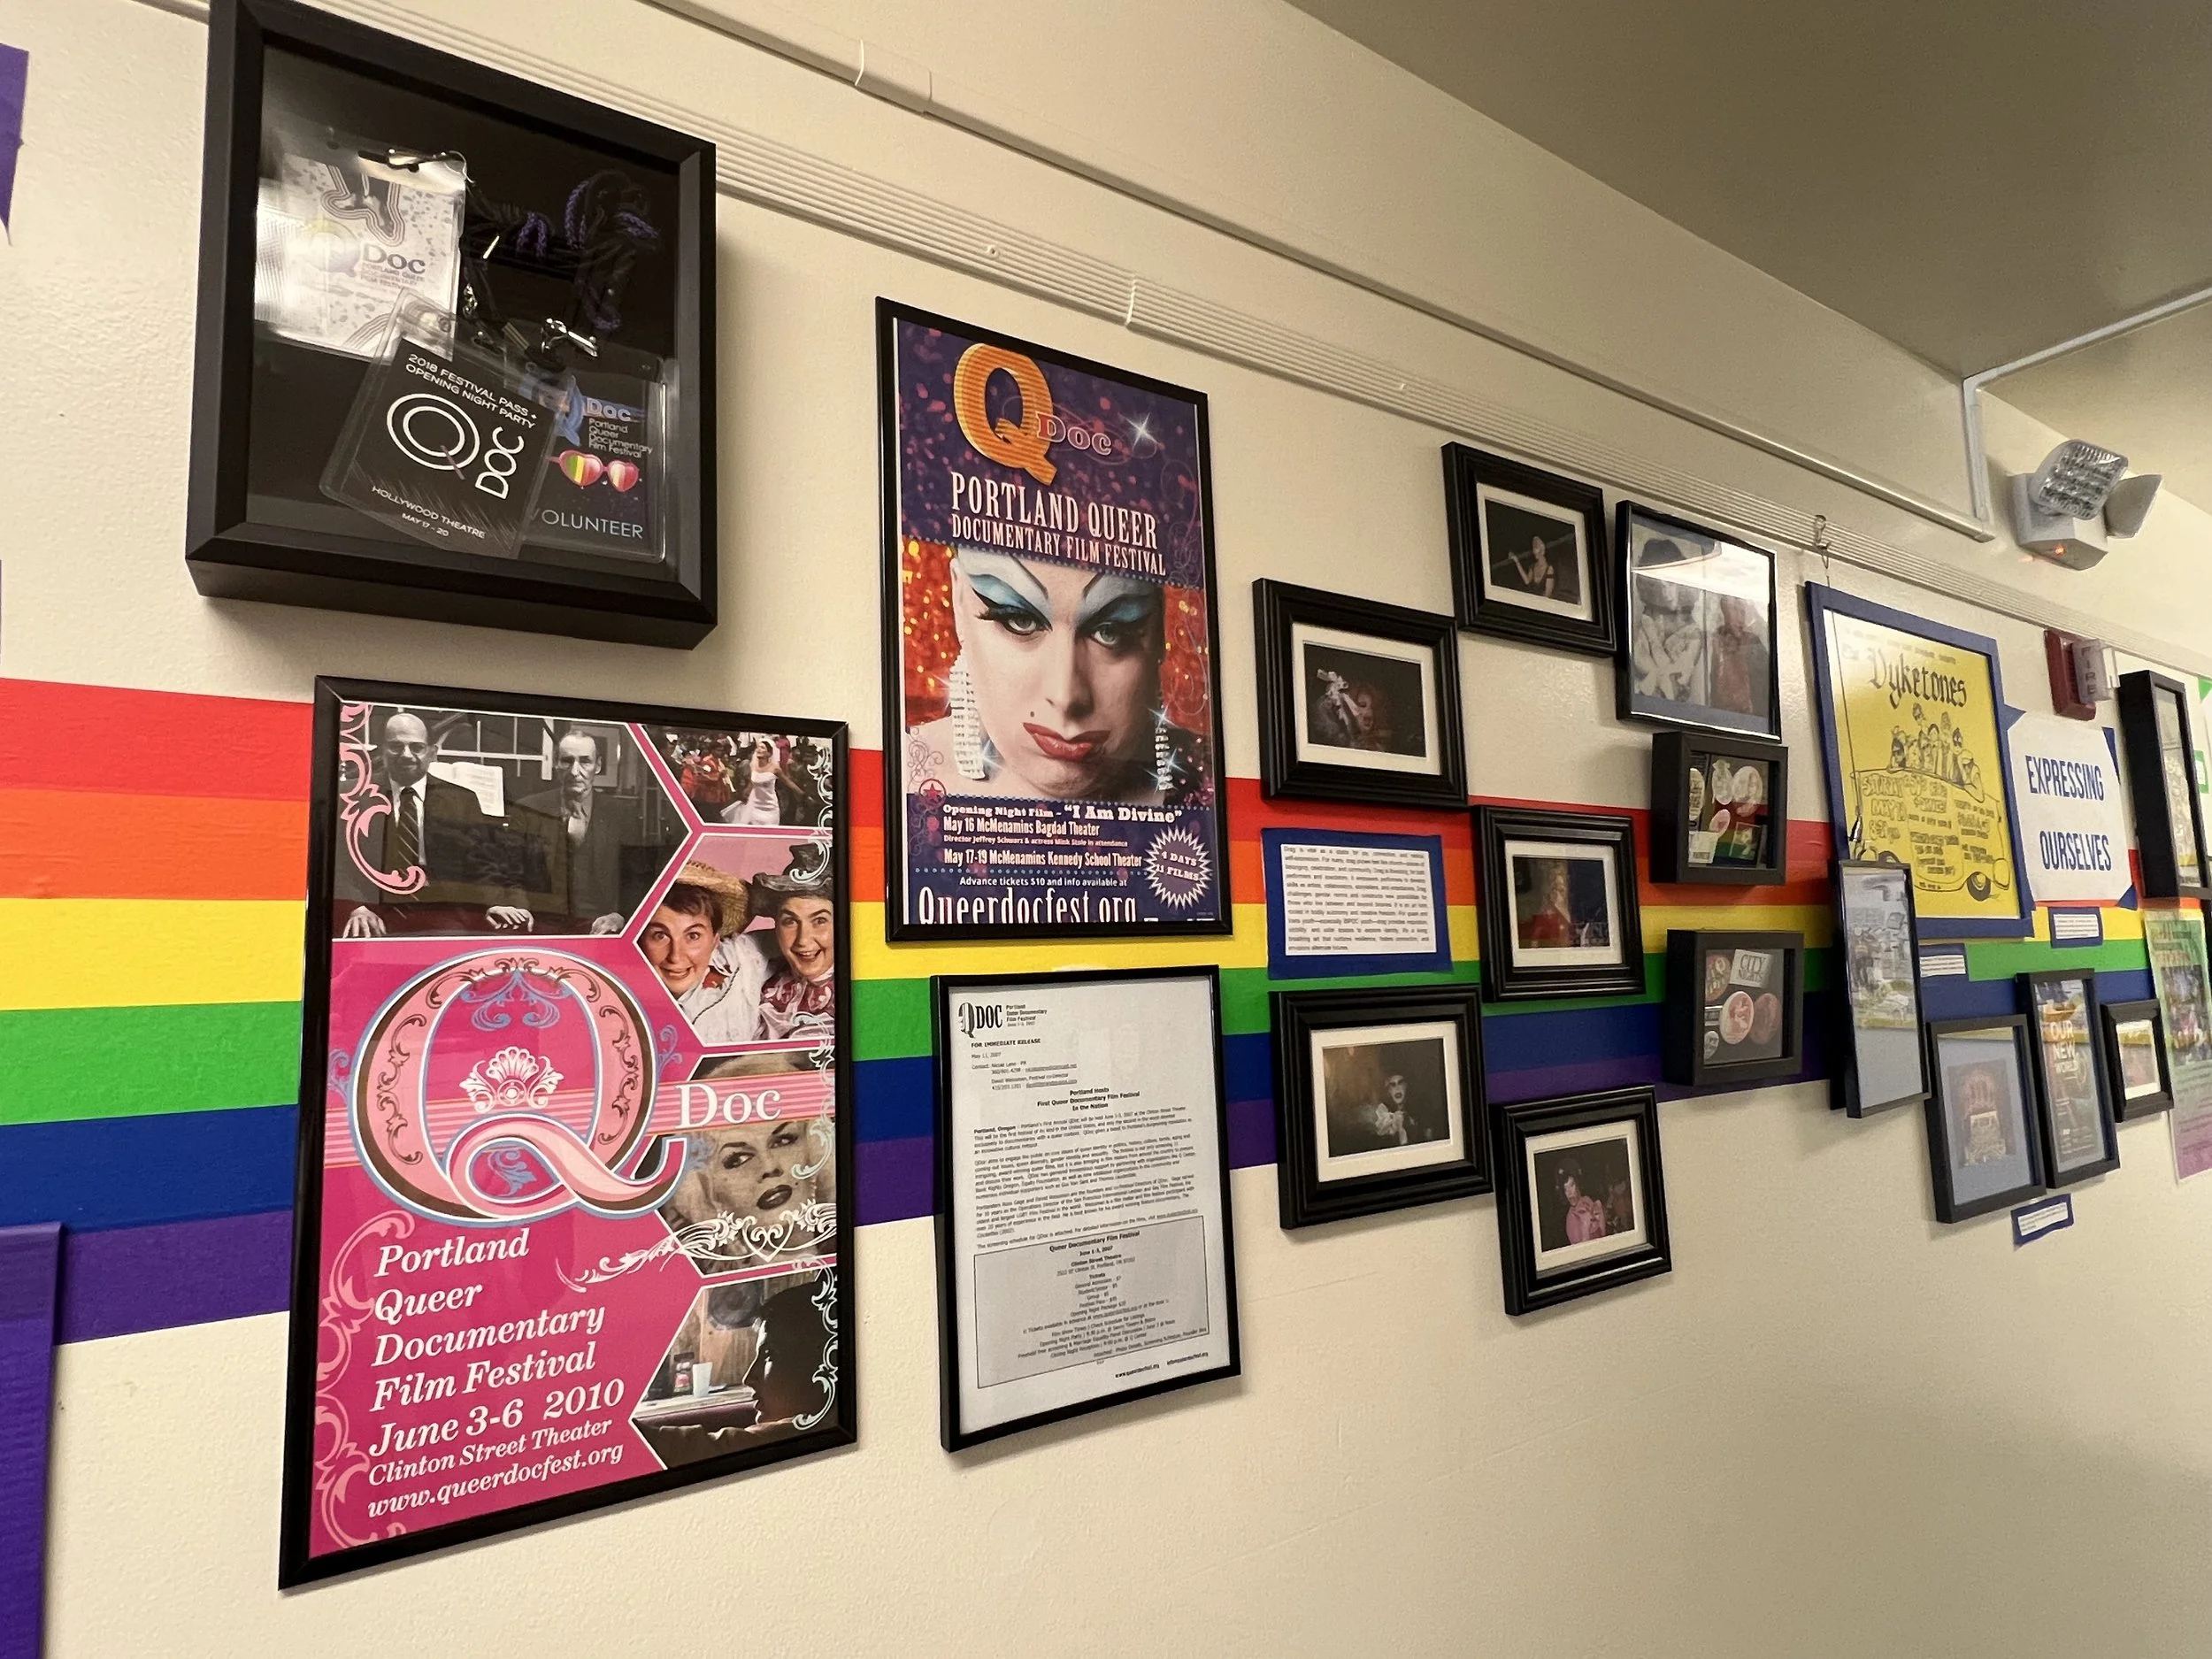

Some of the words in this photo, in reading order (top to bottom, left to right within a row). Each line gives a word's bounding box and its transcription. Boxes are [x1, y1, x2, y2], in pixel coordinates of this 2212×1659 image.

[405, 364, 459, 395] OPENING
[461, 389, 498, 412] NIGHT
[499, 407, 536, 429] PARTY
[408, 353, 438, 373] 2018
[440, 368, 496, 402] FESTIVAL
[498, 396, 529, 418] PASS
[588, 418, 628, 434] Portland
[588, 426, 618, 439] Queer
[588, 433, 654, 455] Documentary
[475, 426, 525, 500] DOC
[588, 442, 608, 452] Film
[609, 443, 642, 458] Festival
[372, 486, 439, 520] HOLLYWOOD
[441, 515, 486, 539] THEATRE
[402, 512, 421, 525] MAY
[436, 526, 449, 538] 20
[951, 471, 1079, 534] PORTLAND
[1087, 502, 1158, 549] QUEER
[952, 513, 1061, 557] DOCUMENTARY
[1066, 535, 1100, 564] FILM
[1104, 543, 1166, 576] FESTIVAL
[1868, 646, 1968, 710] Dyketones
[2080, 646, 2099, 695] FIRE
[2025, 755, 2105, 801] EXPRESSING
[943, 804, 993, 818] Opening
[995, 806, 1026, 818] Night
[1028, 809, 1054, 818] Film
[1085, 806, 1114, 821] Am
[943, 816, 964, 834] May
[964, 818, 975, 831] 16
[976, 818, 1033, 834] McMenamins
[1035, 820, 1067, 837] Bagdad
[1069, 821, 1100, 836] Theater
[944, 848, 964, 867] May
[965, 849, 987, 864] 17-19
[989, 849, 1046, 866] McMenamins
[1048, 851, 1083, 869] Kennedy
[1085, 851, 1111, 867] School
[1113, 852, 1142, 867] Theater
[972, 835, 996, 845] Jeffrey
[1161, 850, 1168, 860] 4
[1170, 852, 1197, 867] DAYS
[2039, 830, 2112, 871] OURSELVES
[959, 876, 997, 886] Advance
[999, 877, 1029, 886] tickets
[1031, 877, 1046, 887] $10
[1047, 877, 1063, 886] and
[1064, 877, 1081, 887] info
[1082, 878, 1118, 887] available
[1166, 867, 1199, 881] FILMS
[2049, 1019, 2075, 1041] OUR
[2053, 1041, 2076, 1060] NEW
[1070, 1095, 1106, 1104] Documentary
[373, 1227, 531, 1278] Portland
[1068, 1238, 1106, 1248] Documentary
[1119, 1231, 1141, 1240] Festival
[374, 1283, 483, 1325] Queer
[371, 1306, 606, 1367] Documentary
[369, 1372, 457, 1412] Film
[461, 1340, 596, 1394] Festival
[368, 1418, 459, 1457] June
[465, 1398, 525, 1437] 3-6
[542, 1378, 625, 1420] 2010
[368, 1455, 456, 1486] Clinton
[459, 1434, 526, 1467] Street
[532, 1418, 612, 1450] Theater
[368, 1444, 624, 1518] www.queerdocfest.org
